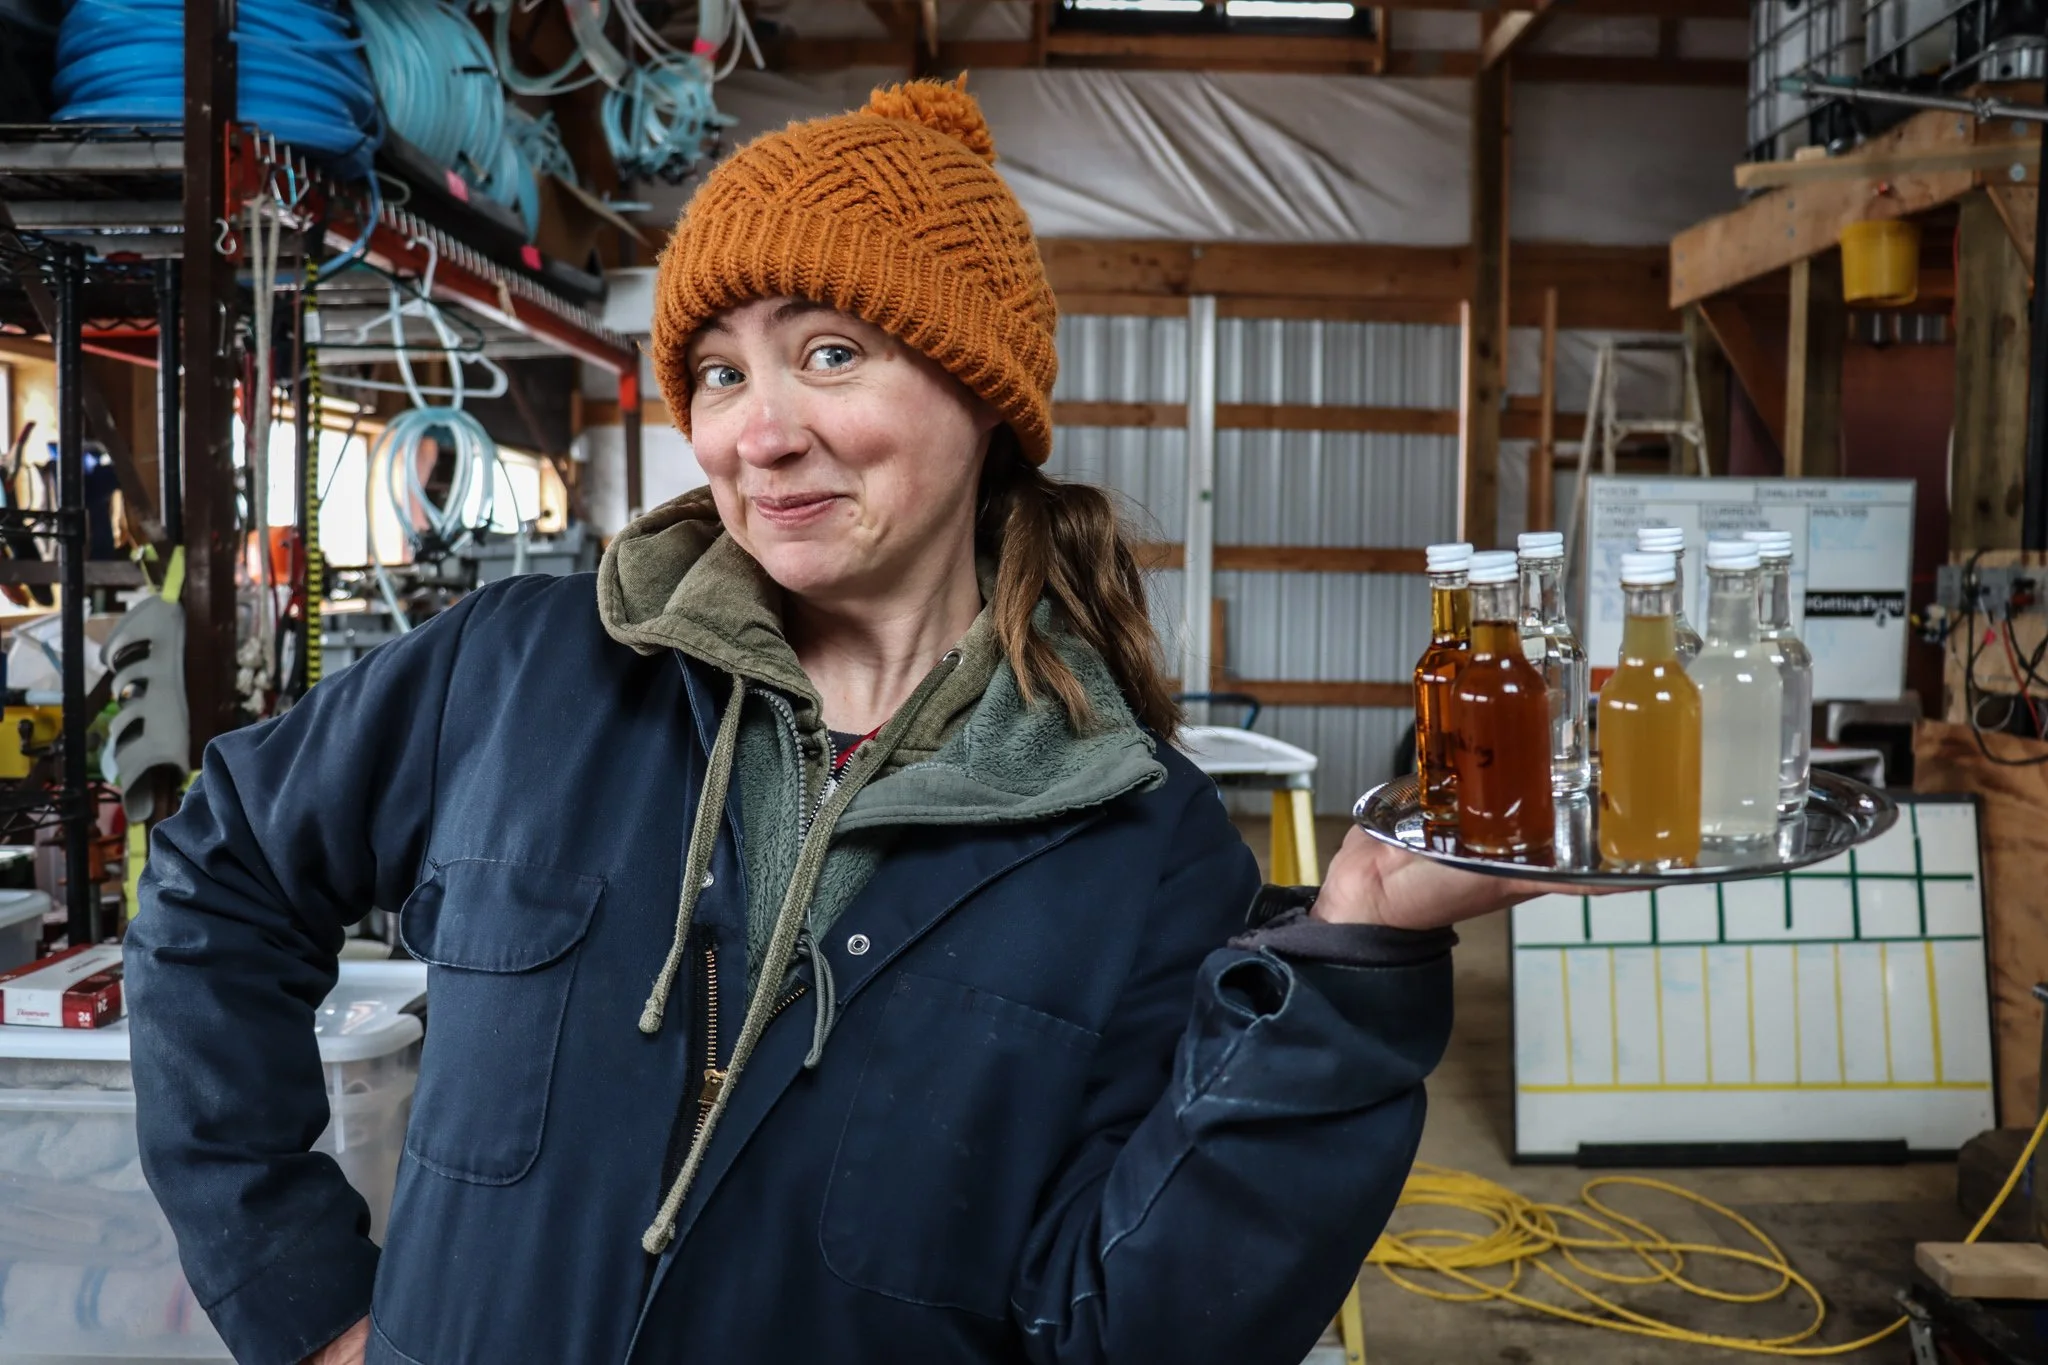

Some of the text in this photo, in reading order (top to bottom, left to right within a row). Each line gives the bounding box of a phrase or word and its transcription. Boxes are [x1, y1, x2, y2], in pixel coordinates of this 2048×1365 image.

[1761, 488, 1828, 498] CHALLENGE
[1705, 506, 1763, 516] CURRENT
[1812, 508, 1869, 518] ANALYSIS
[1705, 519, 1770, 529] CONDITION
[78, 1011, 91, 1022] 24
